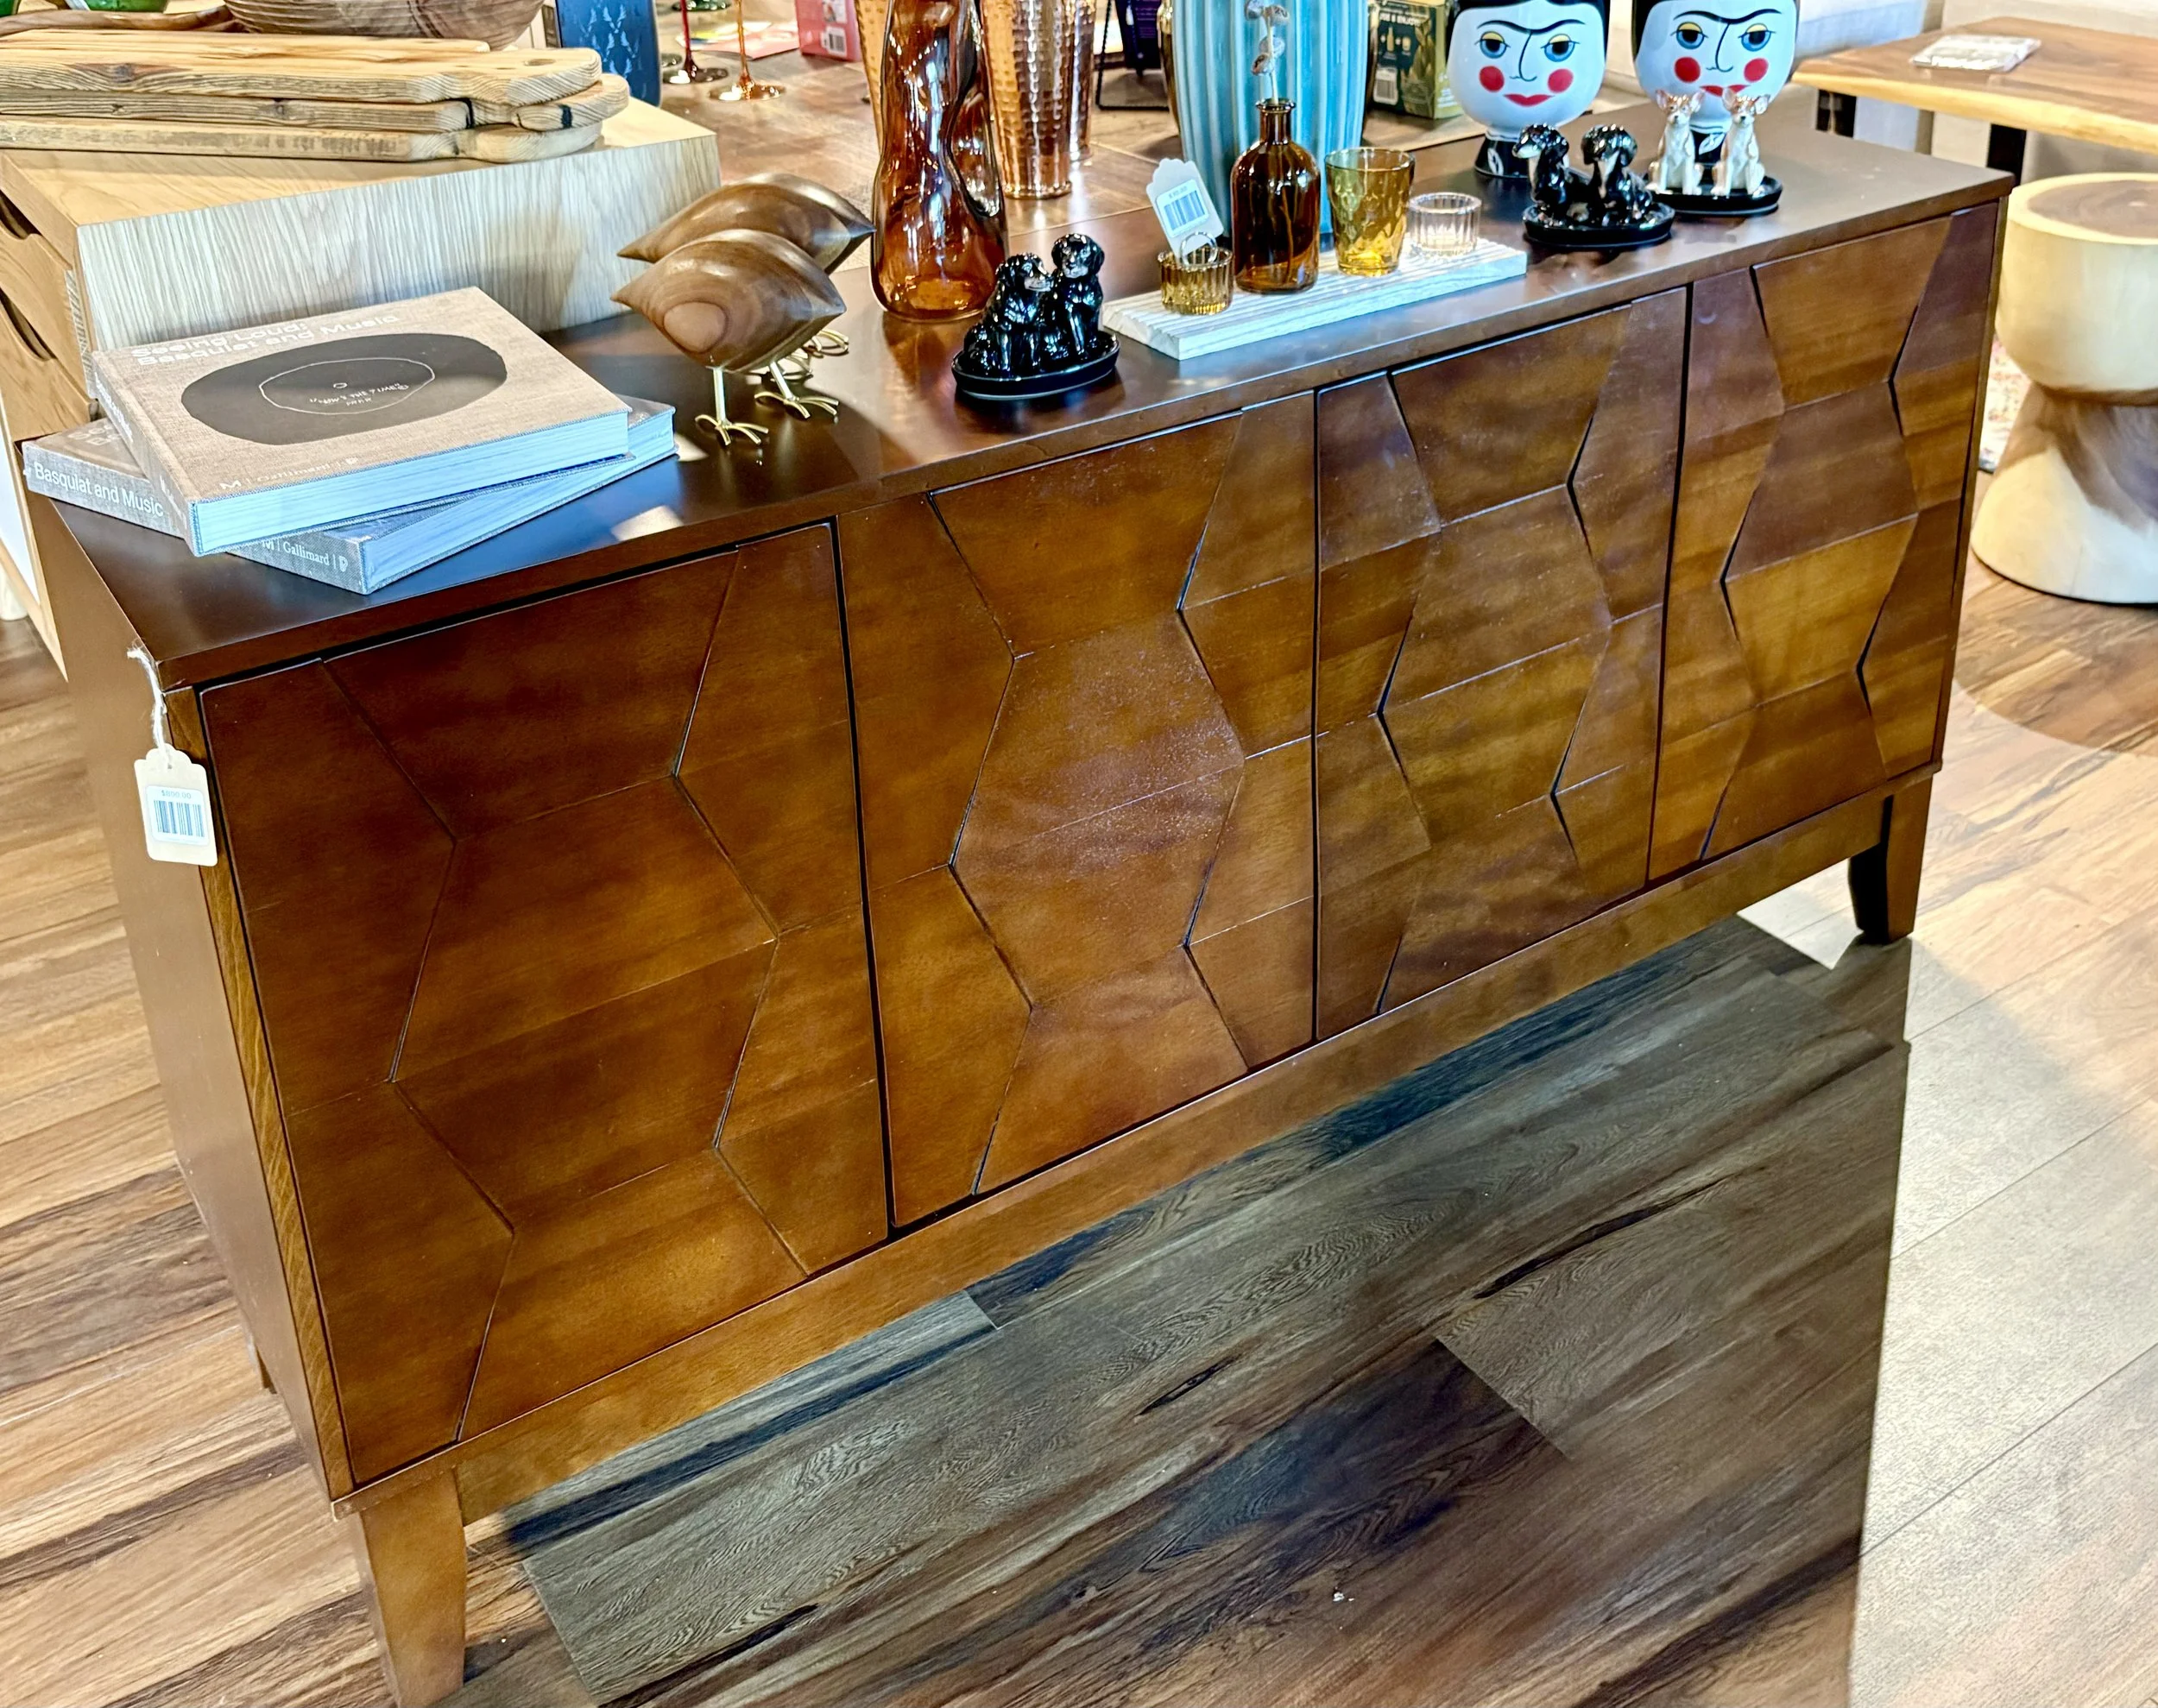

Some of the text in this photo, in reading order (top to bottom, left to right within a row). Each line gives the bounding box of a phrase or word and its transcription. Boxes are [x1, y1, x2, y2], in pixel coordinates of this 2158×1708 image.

[138, 314, 399, 366] Basquiat and Music
[34, 462, 92, 495] Basquiat
[95, 482, 120, 504] and
[122, 488, 164, 517] Music
[283, 540, 330, 566] Gallimard
